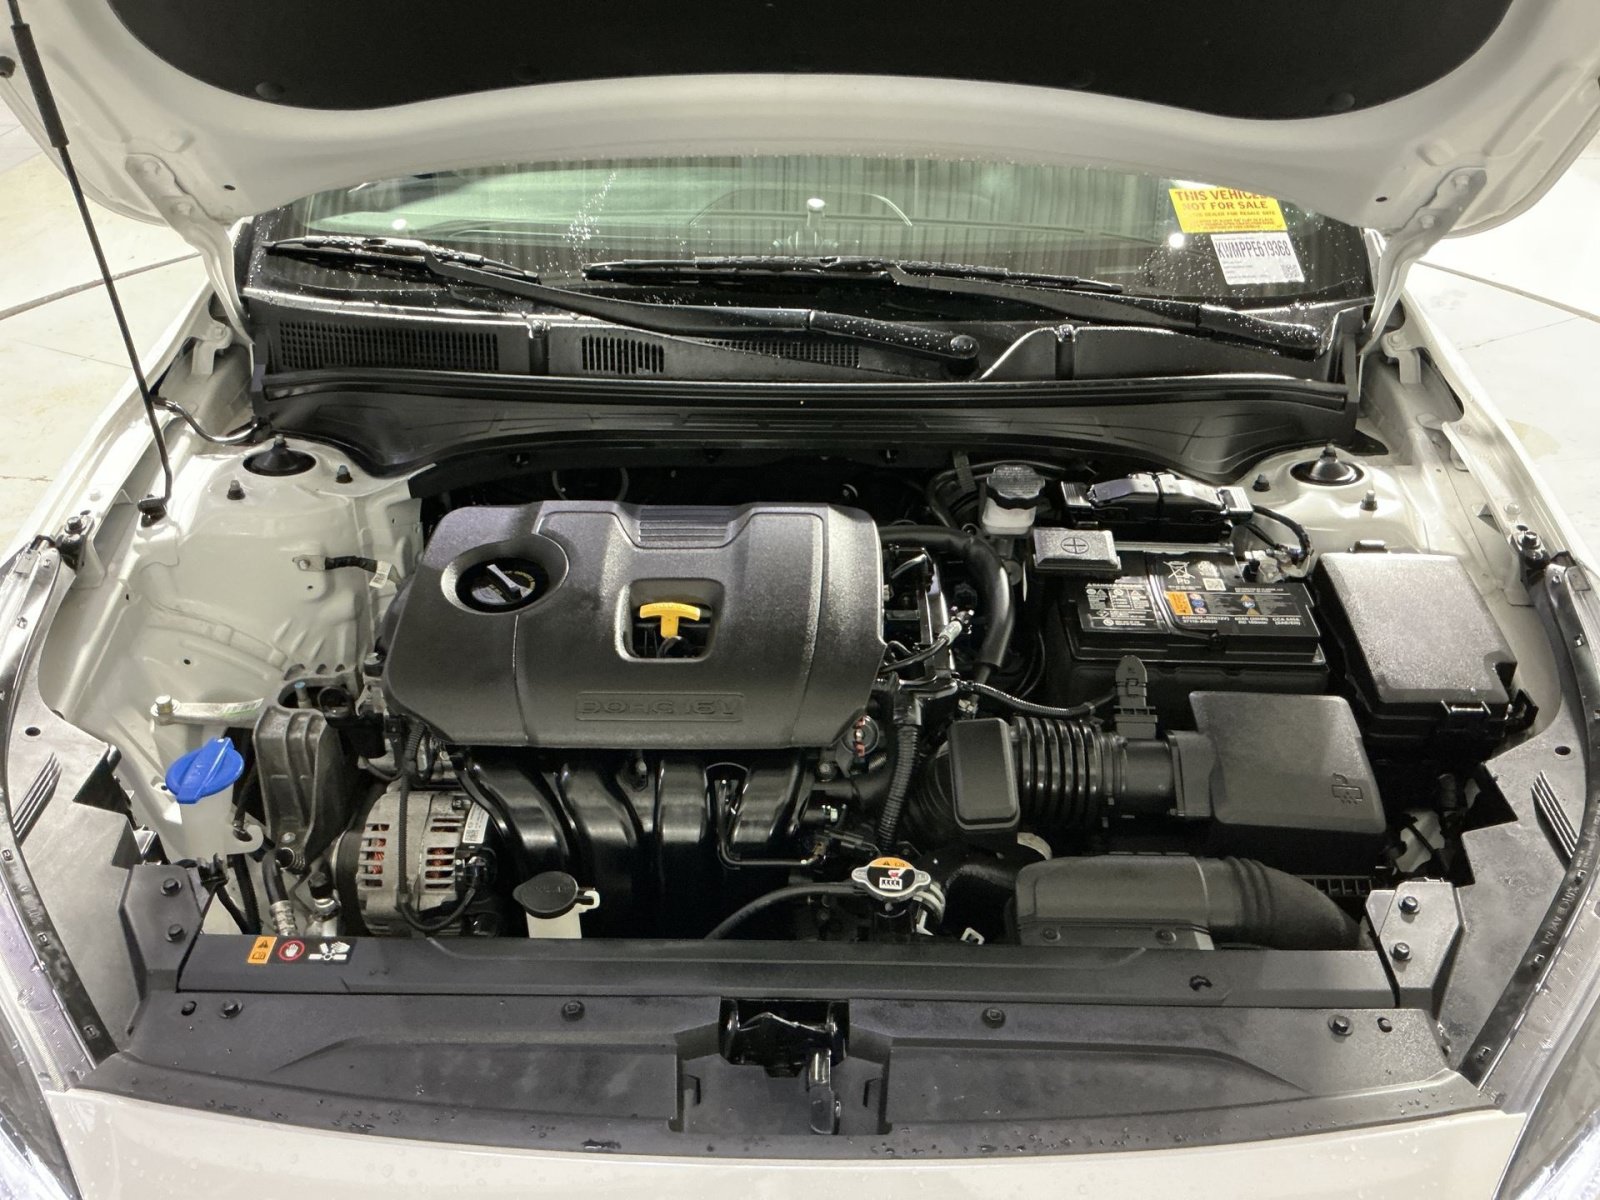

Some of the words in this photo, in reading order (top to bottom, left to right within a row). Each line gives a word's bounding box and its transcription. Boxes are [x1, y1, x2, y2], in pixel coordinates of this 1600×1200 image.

[1175, 190, 1207, 201] THIS
[1209, 189, 1269, 200] VEHIC
[1182, 202, 1206, 211] NOT
[1210, 201, 1235, 210] FOR
[1238, 201, 1268, 209] SALE
[579, 702, 674, 714] DOHC
